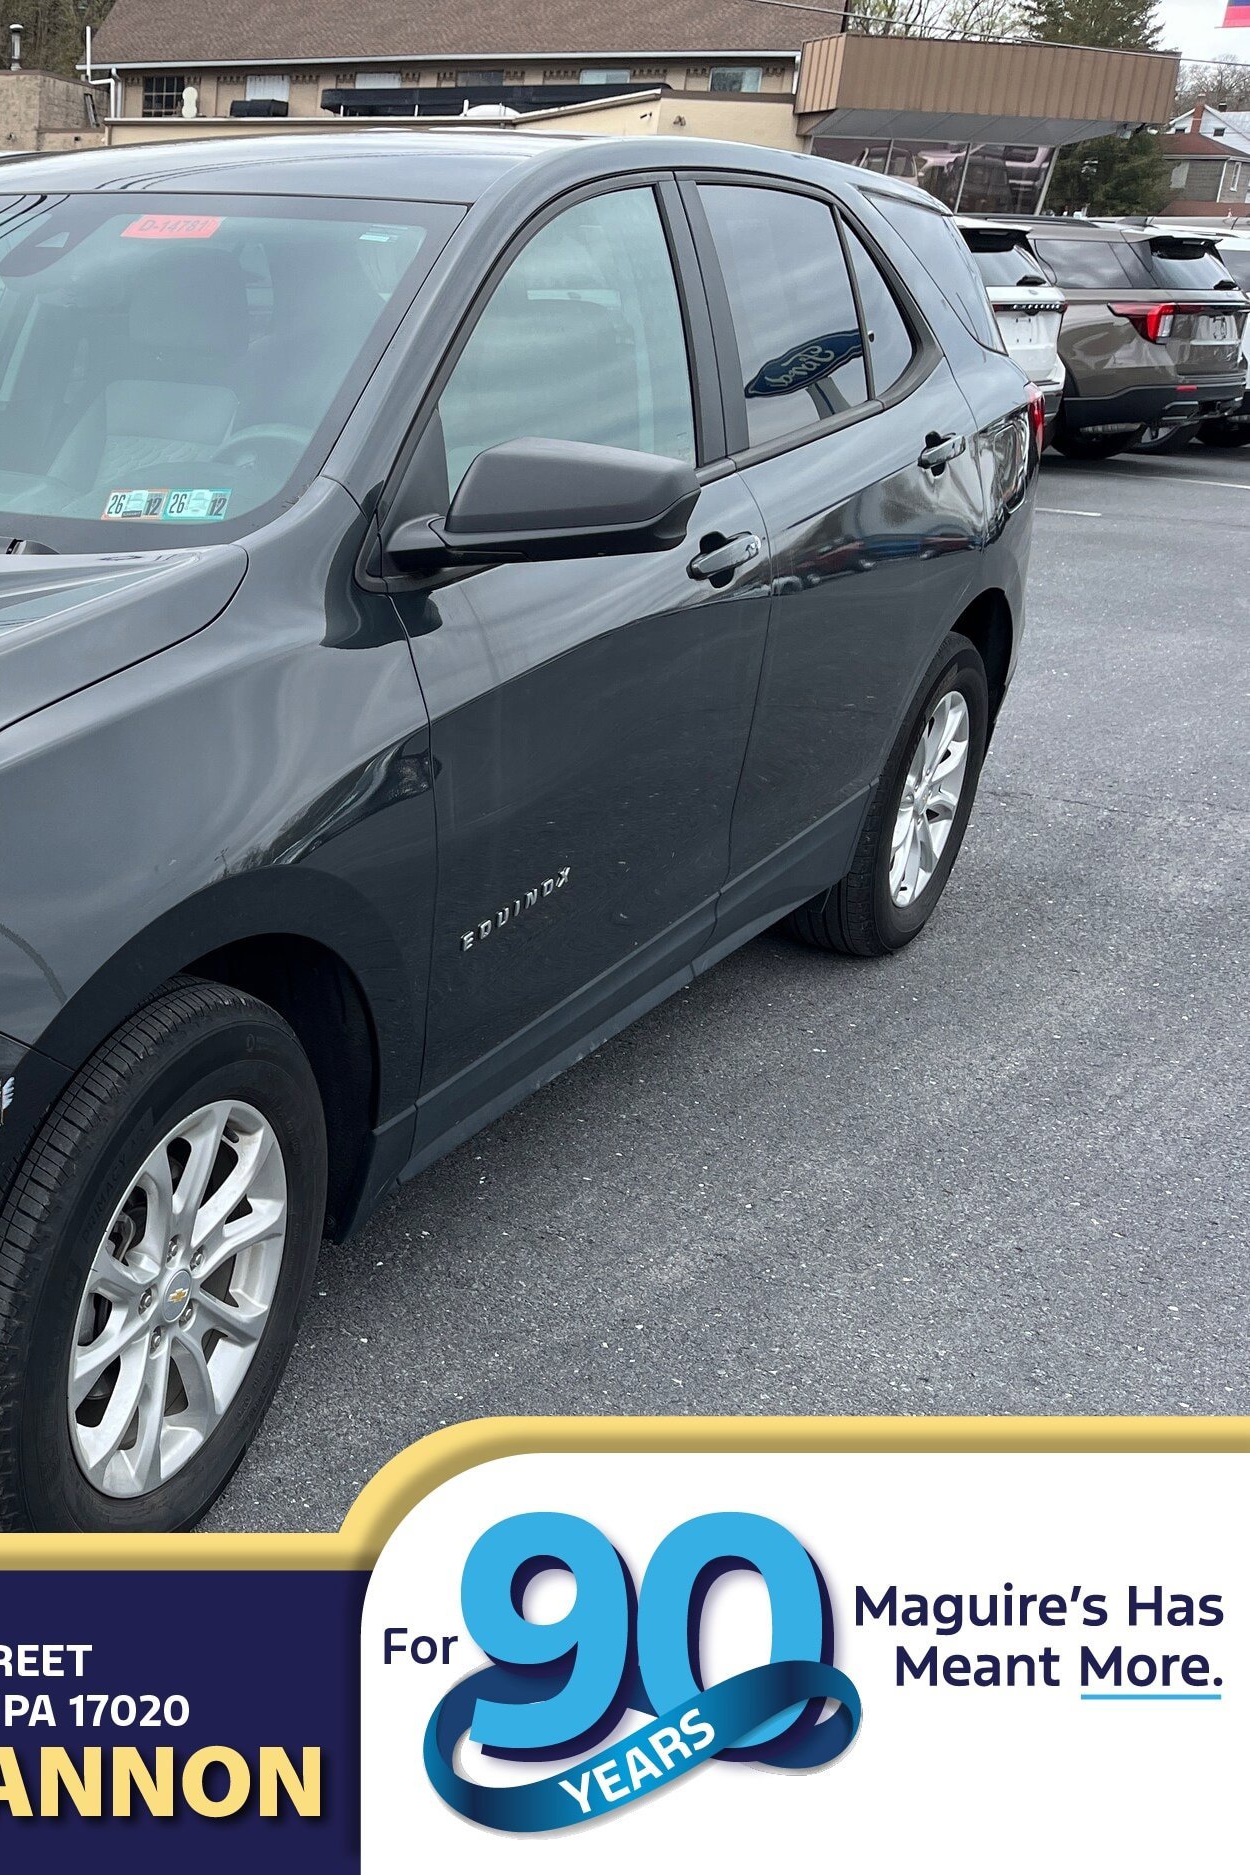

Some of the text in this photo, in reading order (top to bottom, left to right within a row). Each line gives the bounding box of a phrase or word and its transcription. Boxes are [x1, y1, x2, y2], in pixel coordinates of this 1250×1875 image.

[106, 494, 163, 516] 26 12
[168, 493, 228, 516] 26 12
[460, 866, 571, 952] EQUINOX
